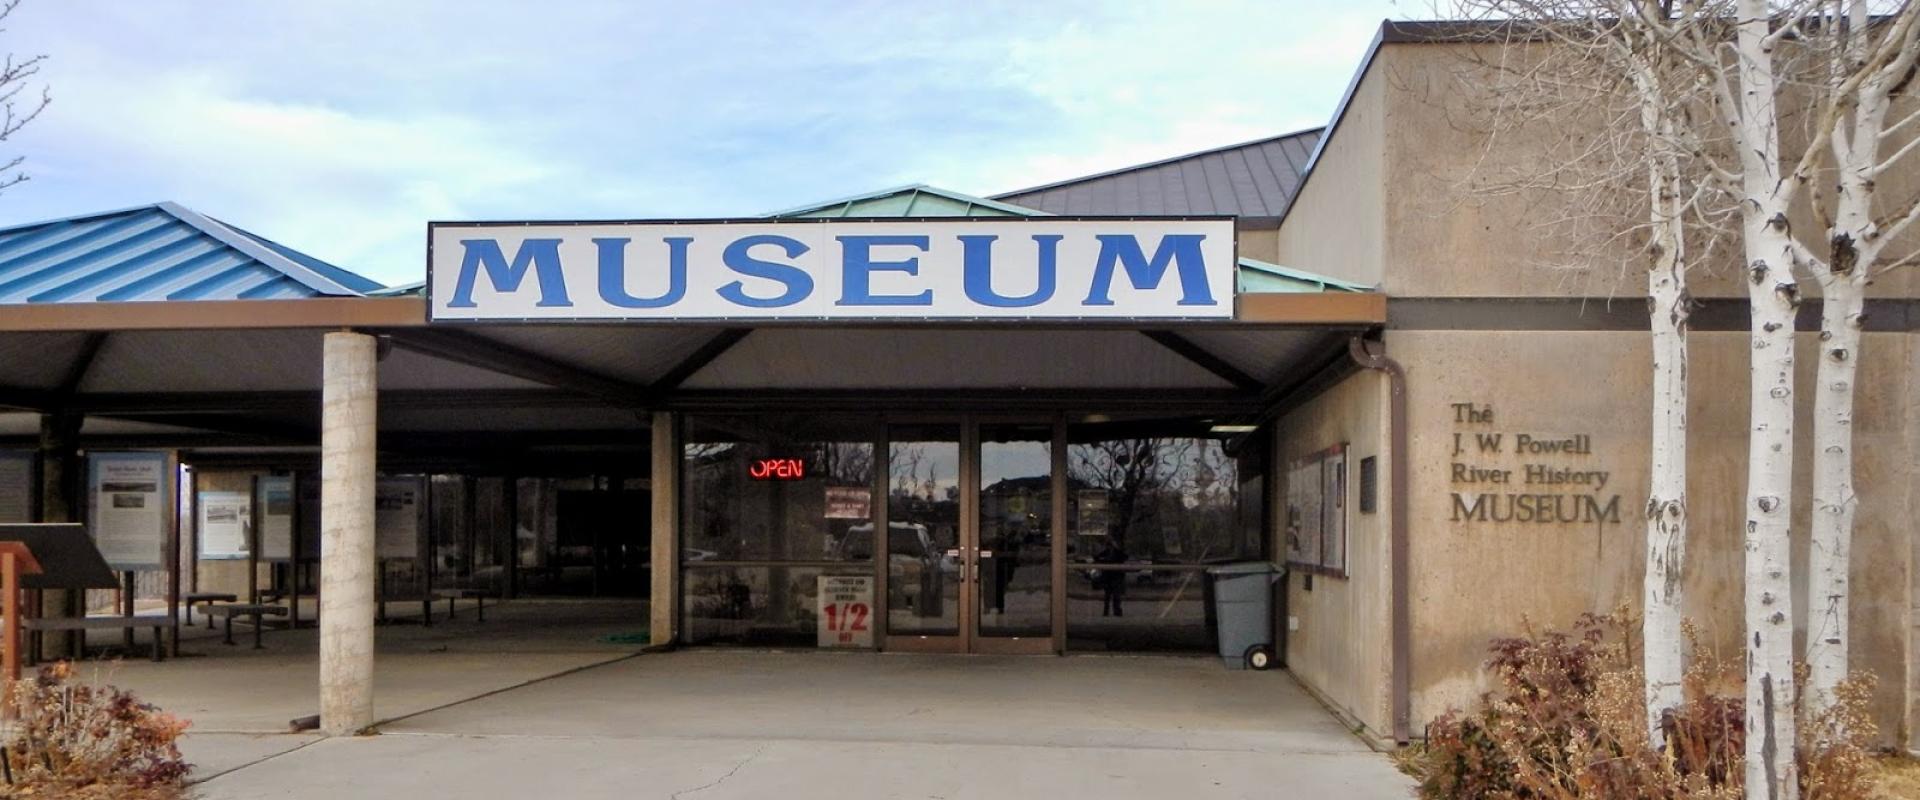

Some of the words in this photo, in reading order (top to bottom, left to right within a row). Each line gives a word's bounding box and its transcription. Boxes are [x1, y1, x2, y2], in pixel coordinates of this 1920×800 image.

[447, 234, 1218, 309] MUSEUM
[1452, 403, 1493, 423] The
[1452, 433, 1464, 457] J.
[1477, 433, 1502, 453] W.
[1515, 434, 1591, 454] Powell
[750, 459, 802, 477] OPEN
[1451, 463, 1512, 483] River
[1525, 464, 1609, 491] History
[1449, 493, 1621, 523] MUSEUM
[824, 603, 869, 631] 1/2
